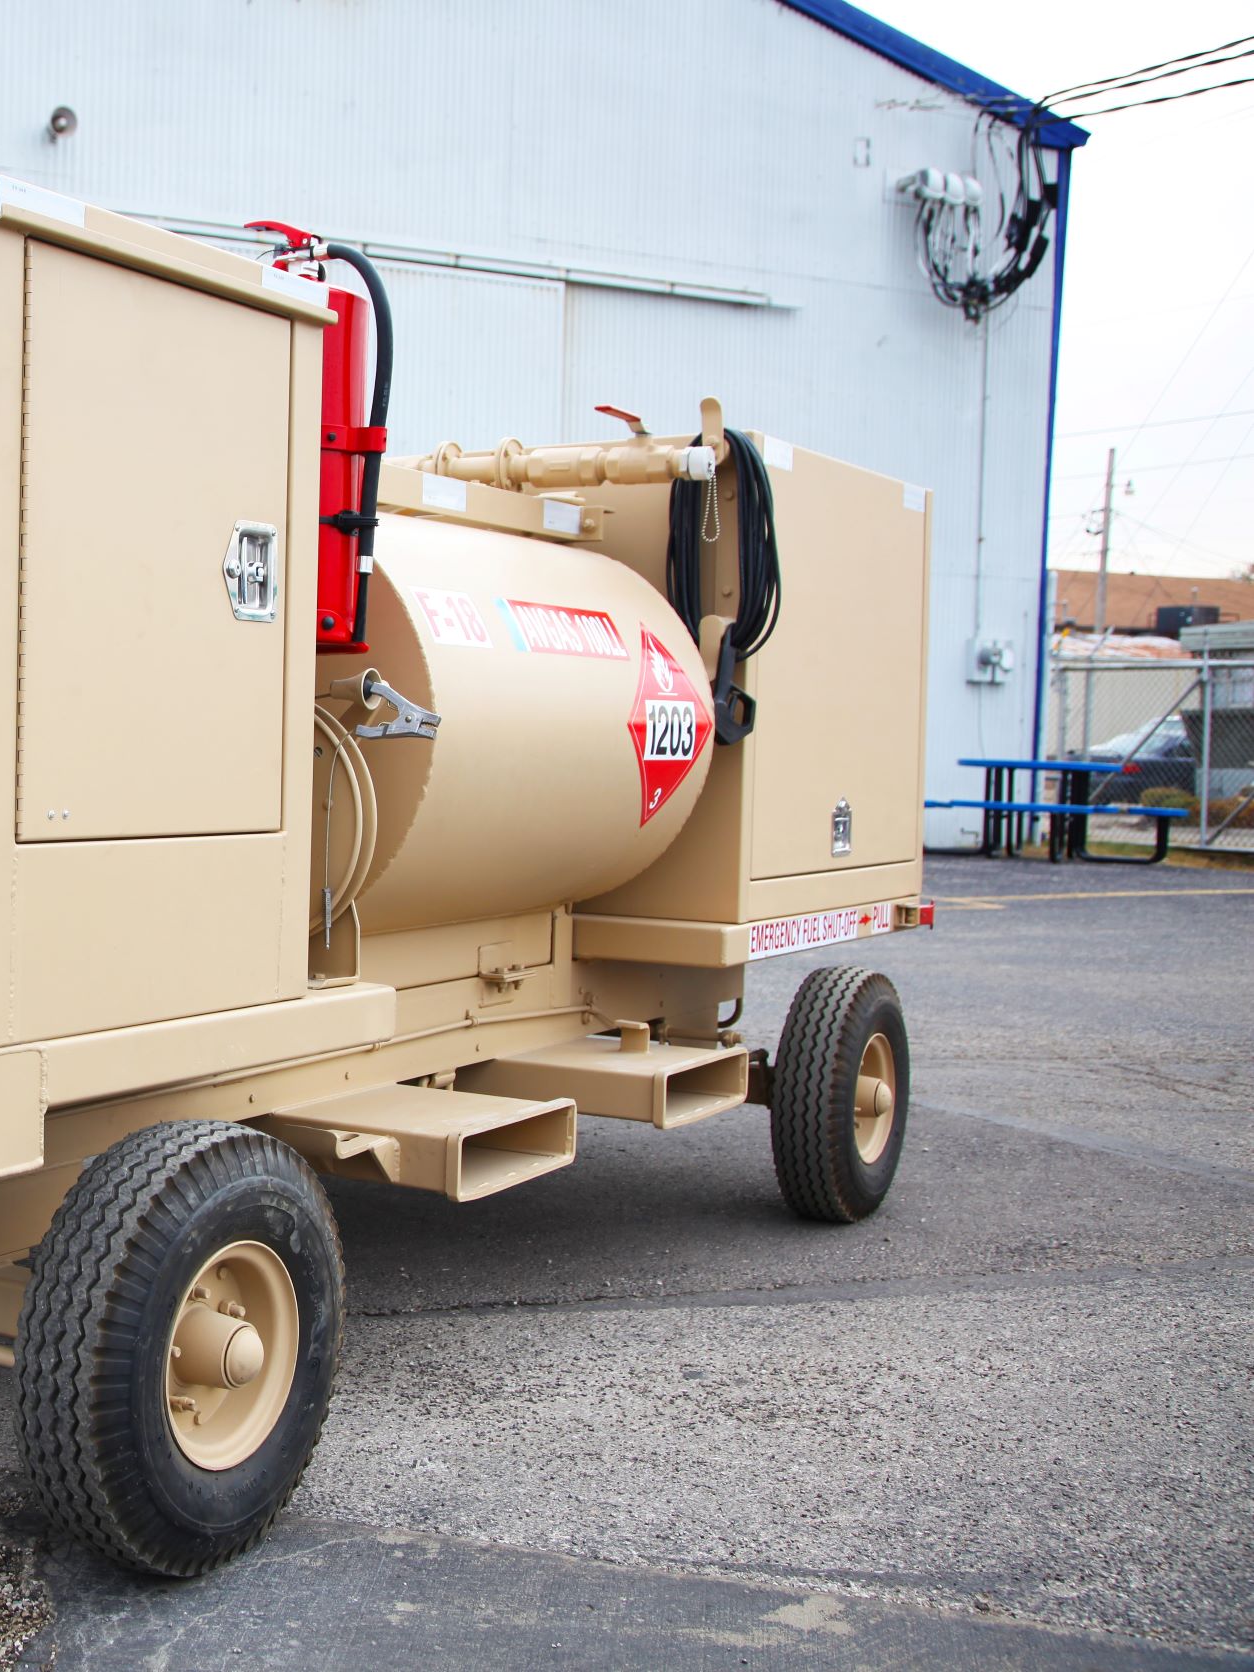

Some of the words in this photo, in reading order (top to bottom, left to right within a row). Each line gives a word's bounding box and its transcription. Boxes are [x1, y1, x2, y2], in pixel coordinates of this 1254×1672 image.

[414, 591, 487, 643] F-18
[514, 605, 584, 653] AVGAS
[574, 614, 628, 657] 100LL
[648, 704, 693, 757] 1203
[649, 787, 662, 809] 3
[750, 921, 802, 953] EMERGENCY
[802, 917, 821, 944] FUEL
[822, 910, 858, 941] SHUT-OFF
[873, 904, 889, 929] PULL
